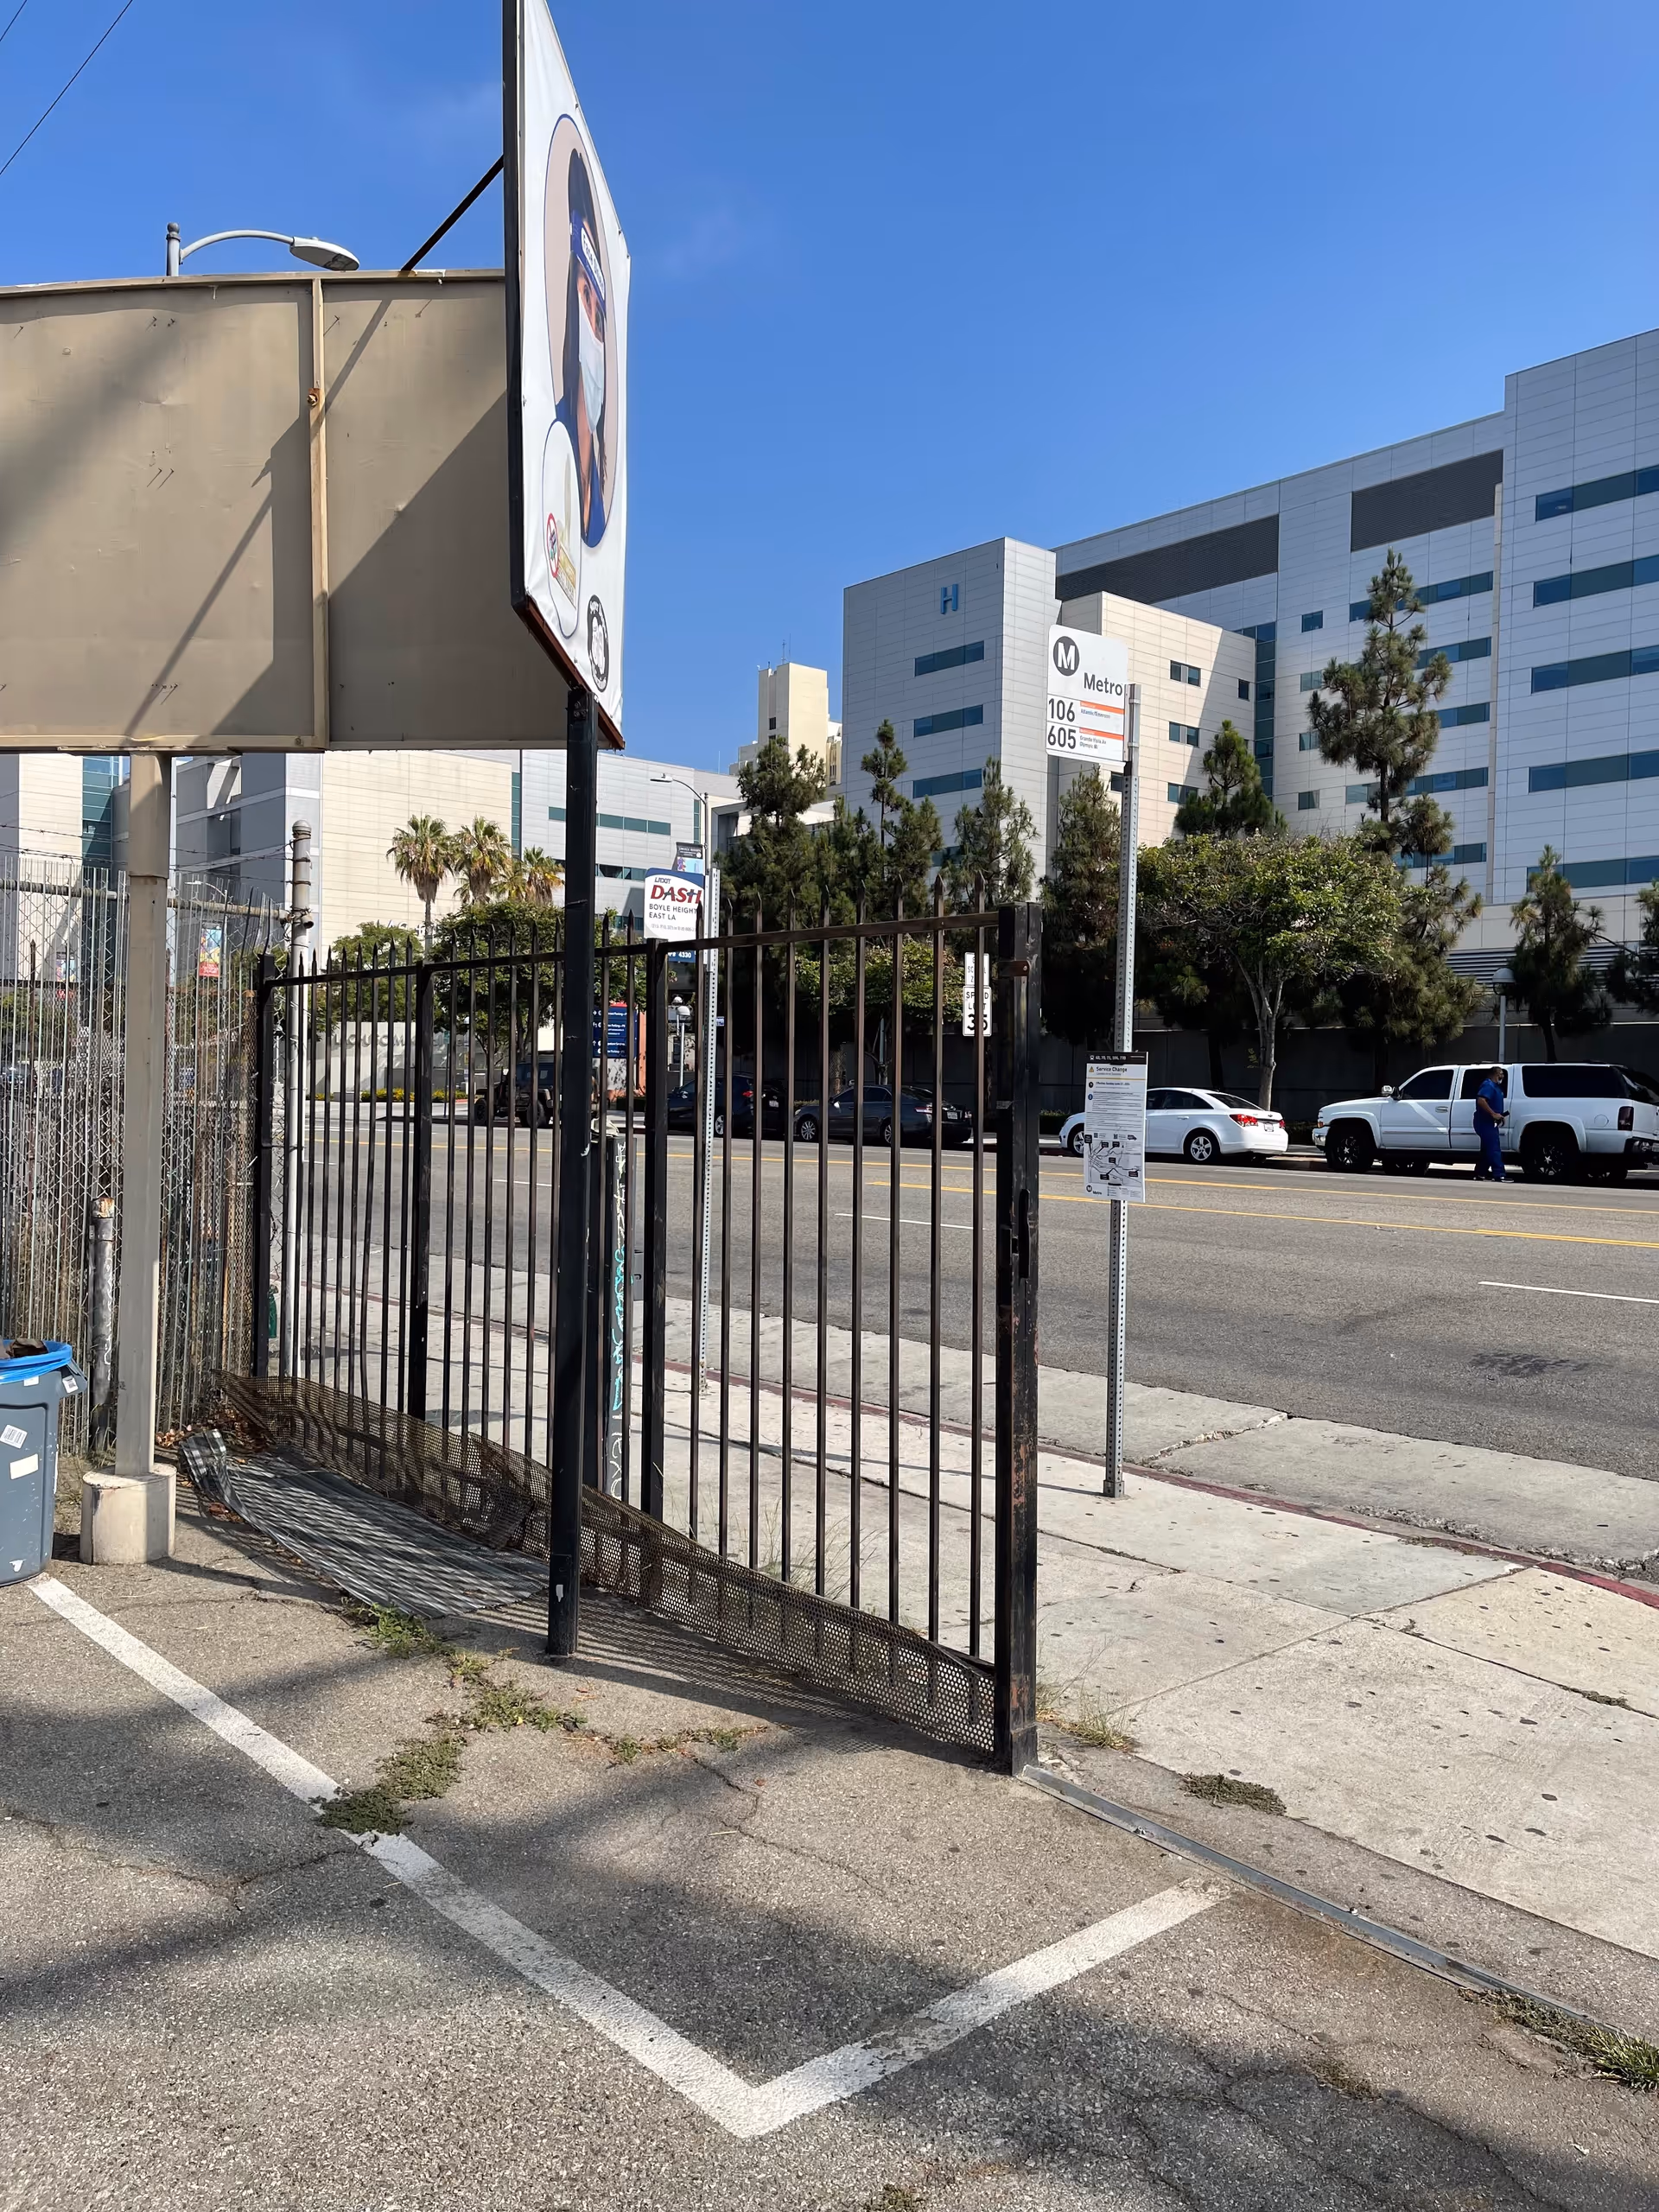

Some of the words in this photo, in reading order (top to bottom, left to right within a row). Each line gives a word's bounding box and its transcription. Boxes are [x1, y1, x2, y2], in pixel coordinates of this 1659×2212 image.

[940, 583, 958, 614] H
[1084, 672, 1122, 696] Metro
[1048, 698, 1075, 722] 106
[1047, 725, 1077, 749] 605
[651, 885, 702, 904] DASH
[649, 903, 671, 912] BOYLE
